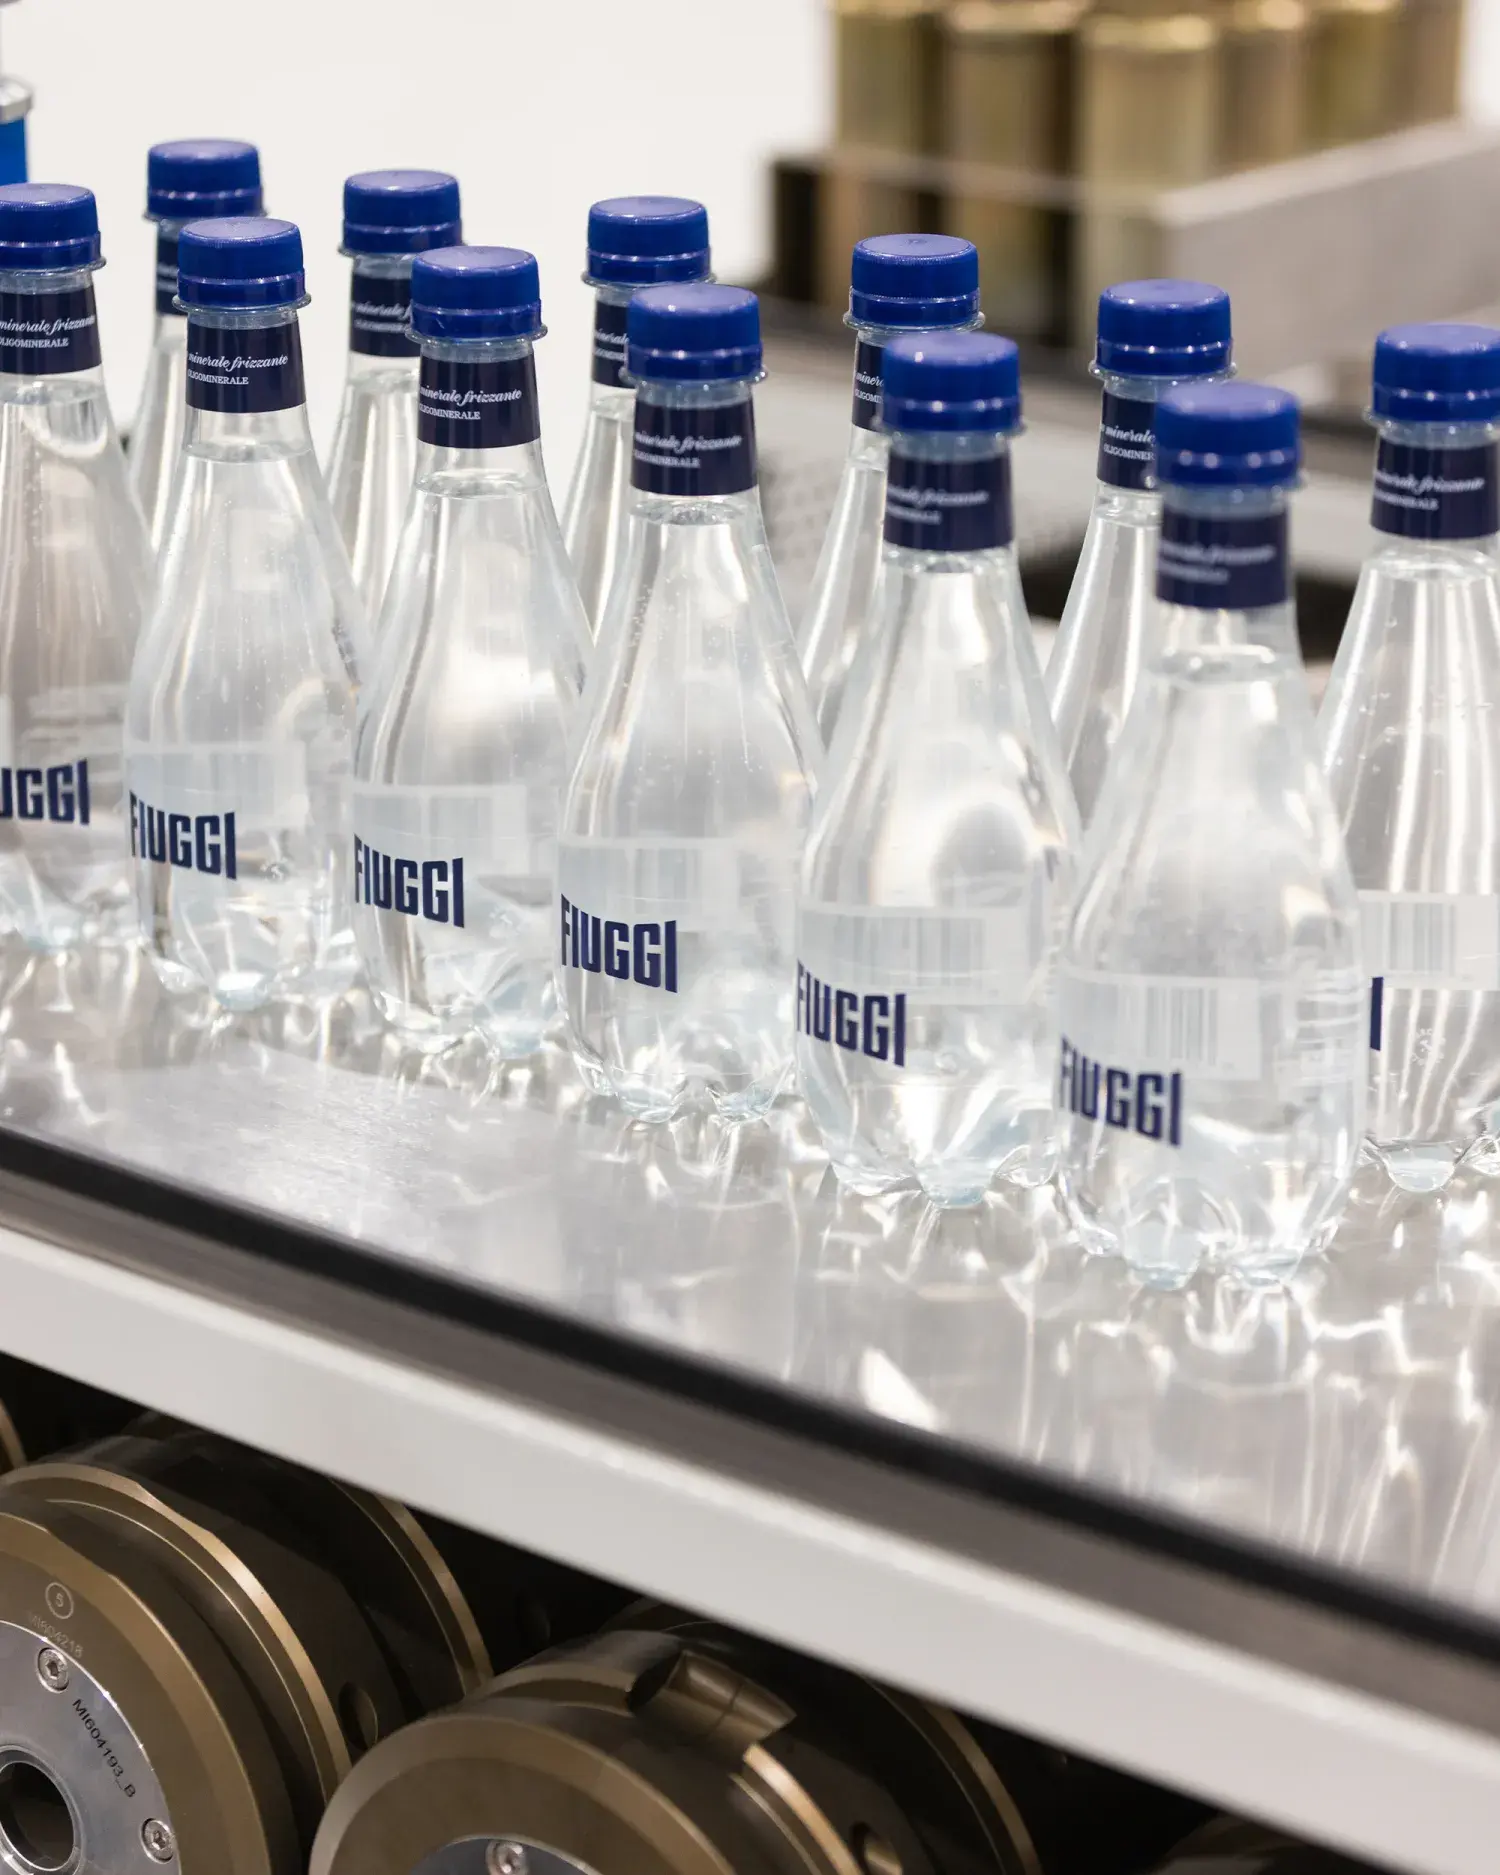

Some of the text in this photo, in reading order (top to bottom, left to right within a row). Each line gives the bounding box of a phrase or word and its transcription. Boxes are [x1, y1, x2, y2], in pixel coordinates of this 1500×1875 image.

[225, 356, 289, 372] frizzante
[456, 388, 522, 406] frizzante
[1104, 443, 1156, 460] OLIGOMINER
[129, 790, 237, 880] FIUGGI
[354, 832, 464, 928] FIUGGI
[560, 893, 678, 993] FIUGGI
[797, 959, 906, 1068] FIUGGI
[1060, 1034, 1182, 1148] FIUGGI
[72, 1698, 136, 1799] MI604193_B
